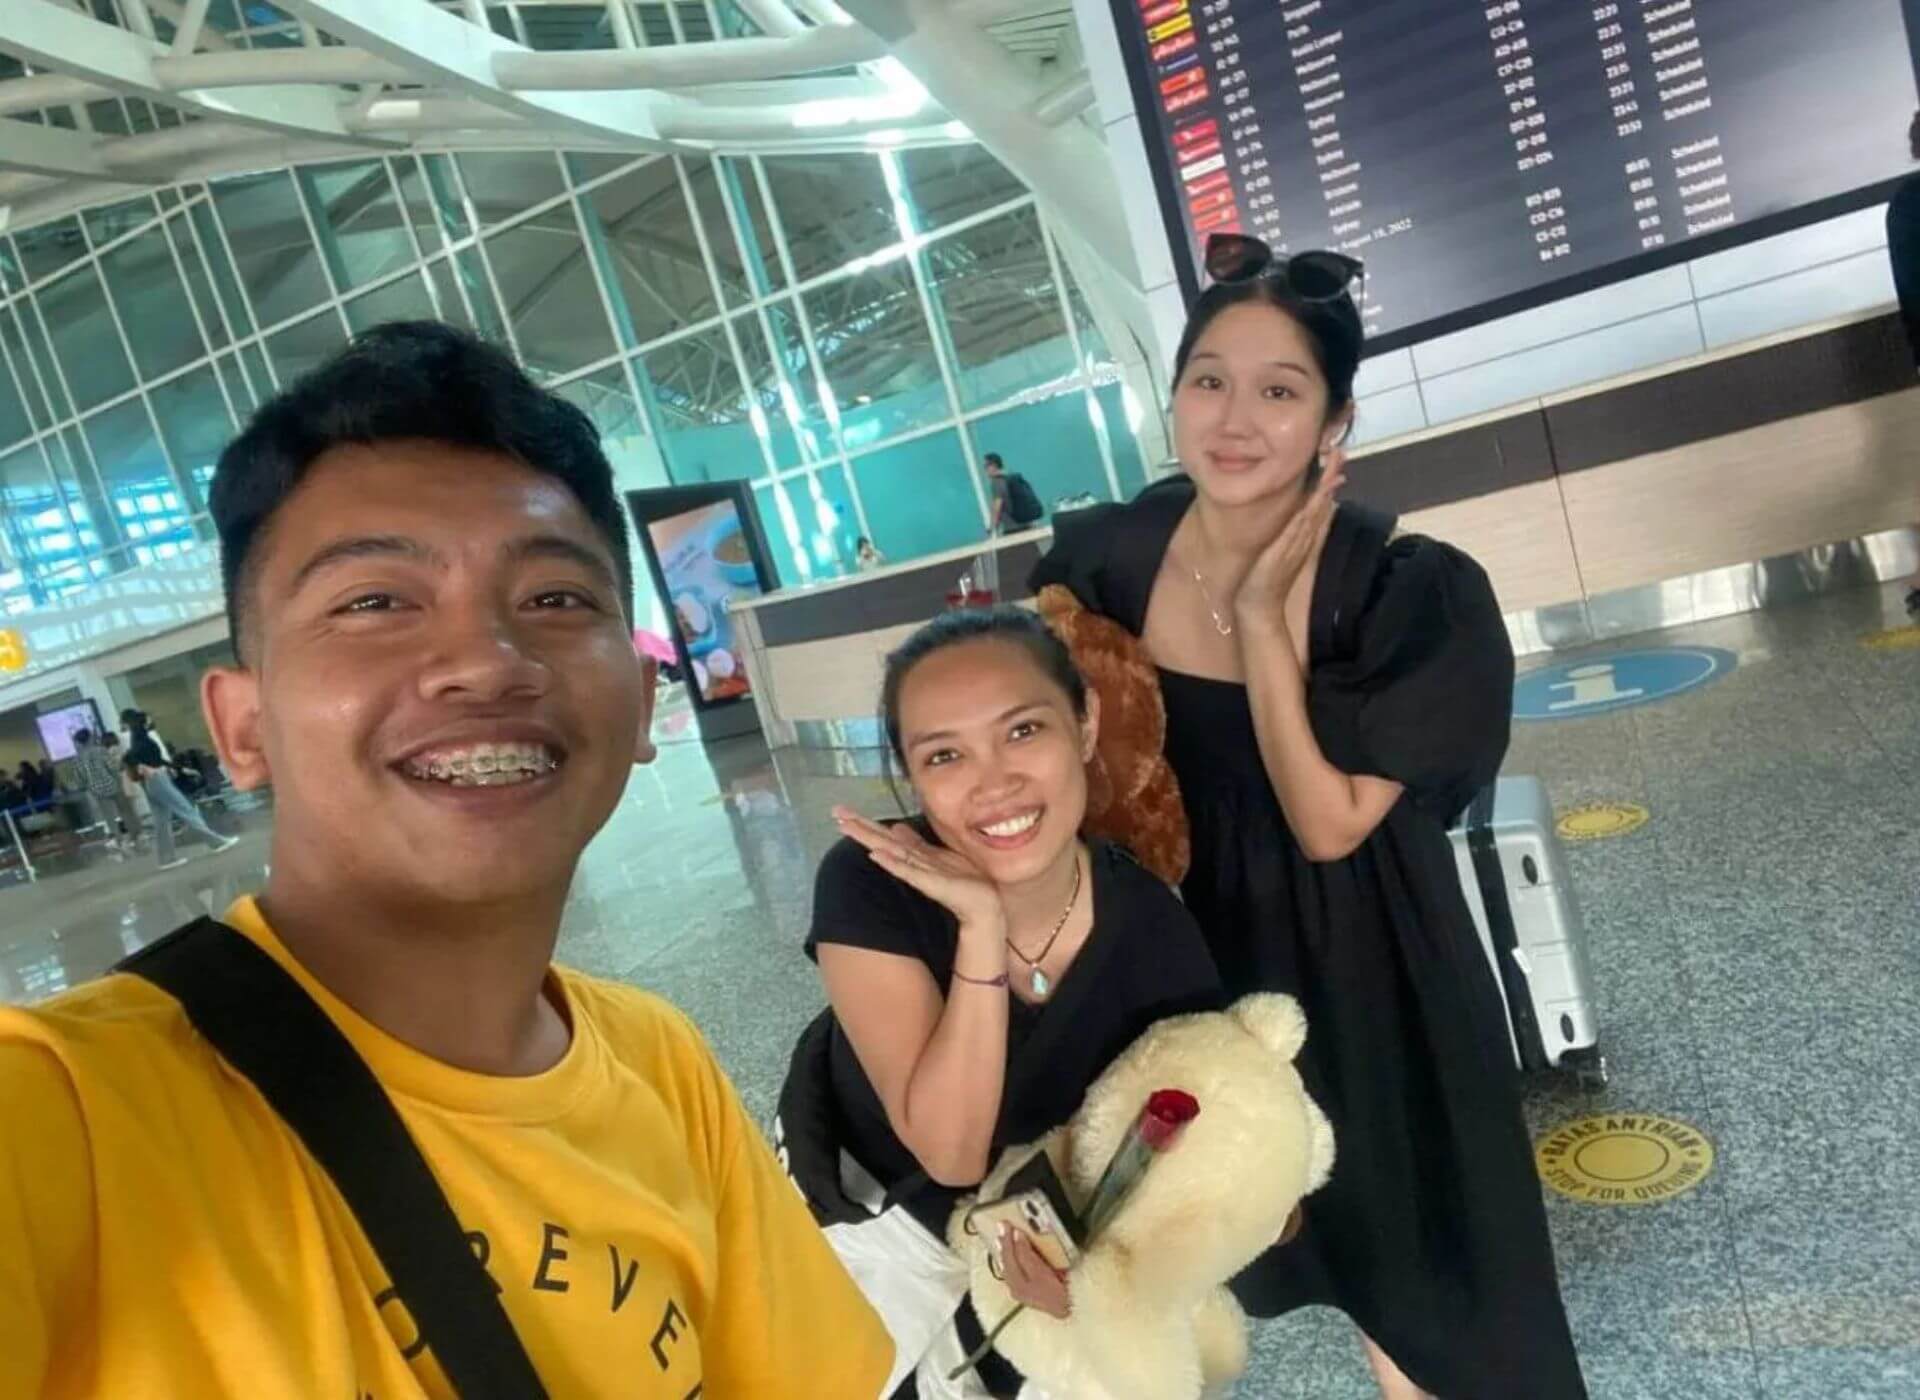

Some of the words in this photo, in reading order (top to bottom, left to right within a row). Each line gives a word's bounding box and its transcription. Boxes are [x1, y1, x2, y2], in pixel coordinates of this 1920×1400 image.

[1647, 18, 1695, 43] Scheduled
[1651, 37, 1699, 63] Scheduled
[1655, 57, 1703, 82] Scheduled
[1659, 77, 1708, 101] Scheduled
[1663, 96, 1711, 121] Scheduled
[1671, 135, 1719, 159] Scheduled
[1675, 154, 1723, 178] Scheduled
[1679, 173, 1727, 197] Scheduled
[1683, 193, 1731, 216] Scheduled
[1687, 212, 1734, 236] Scheduled
[1585, 1185, 1625, 1200] FOR
